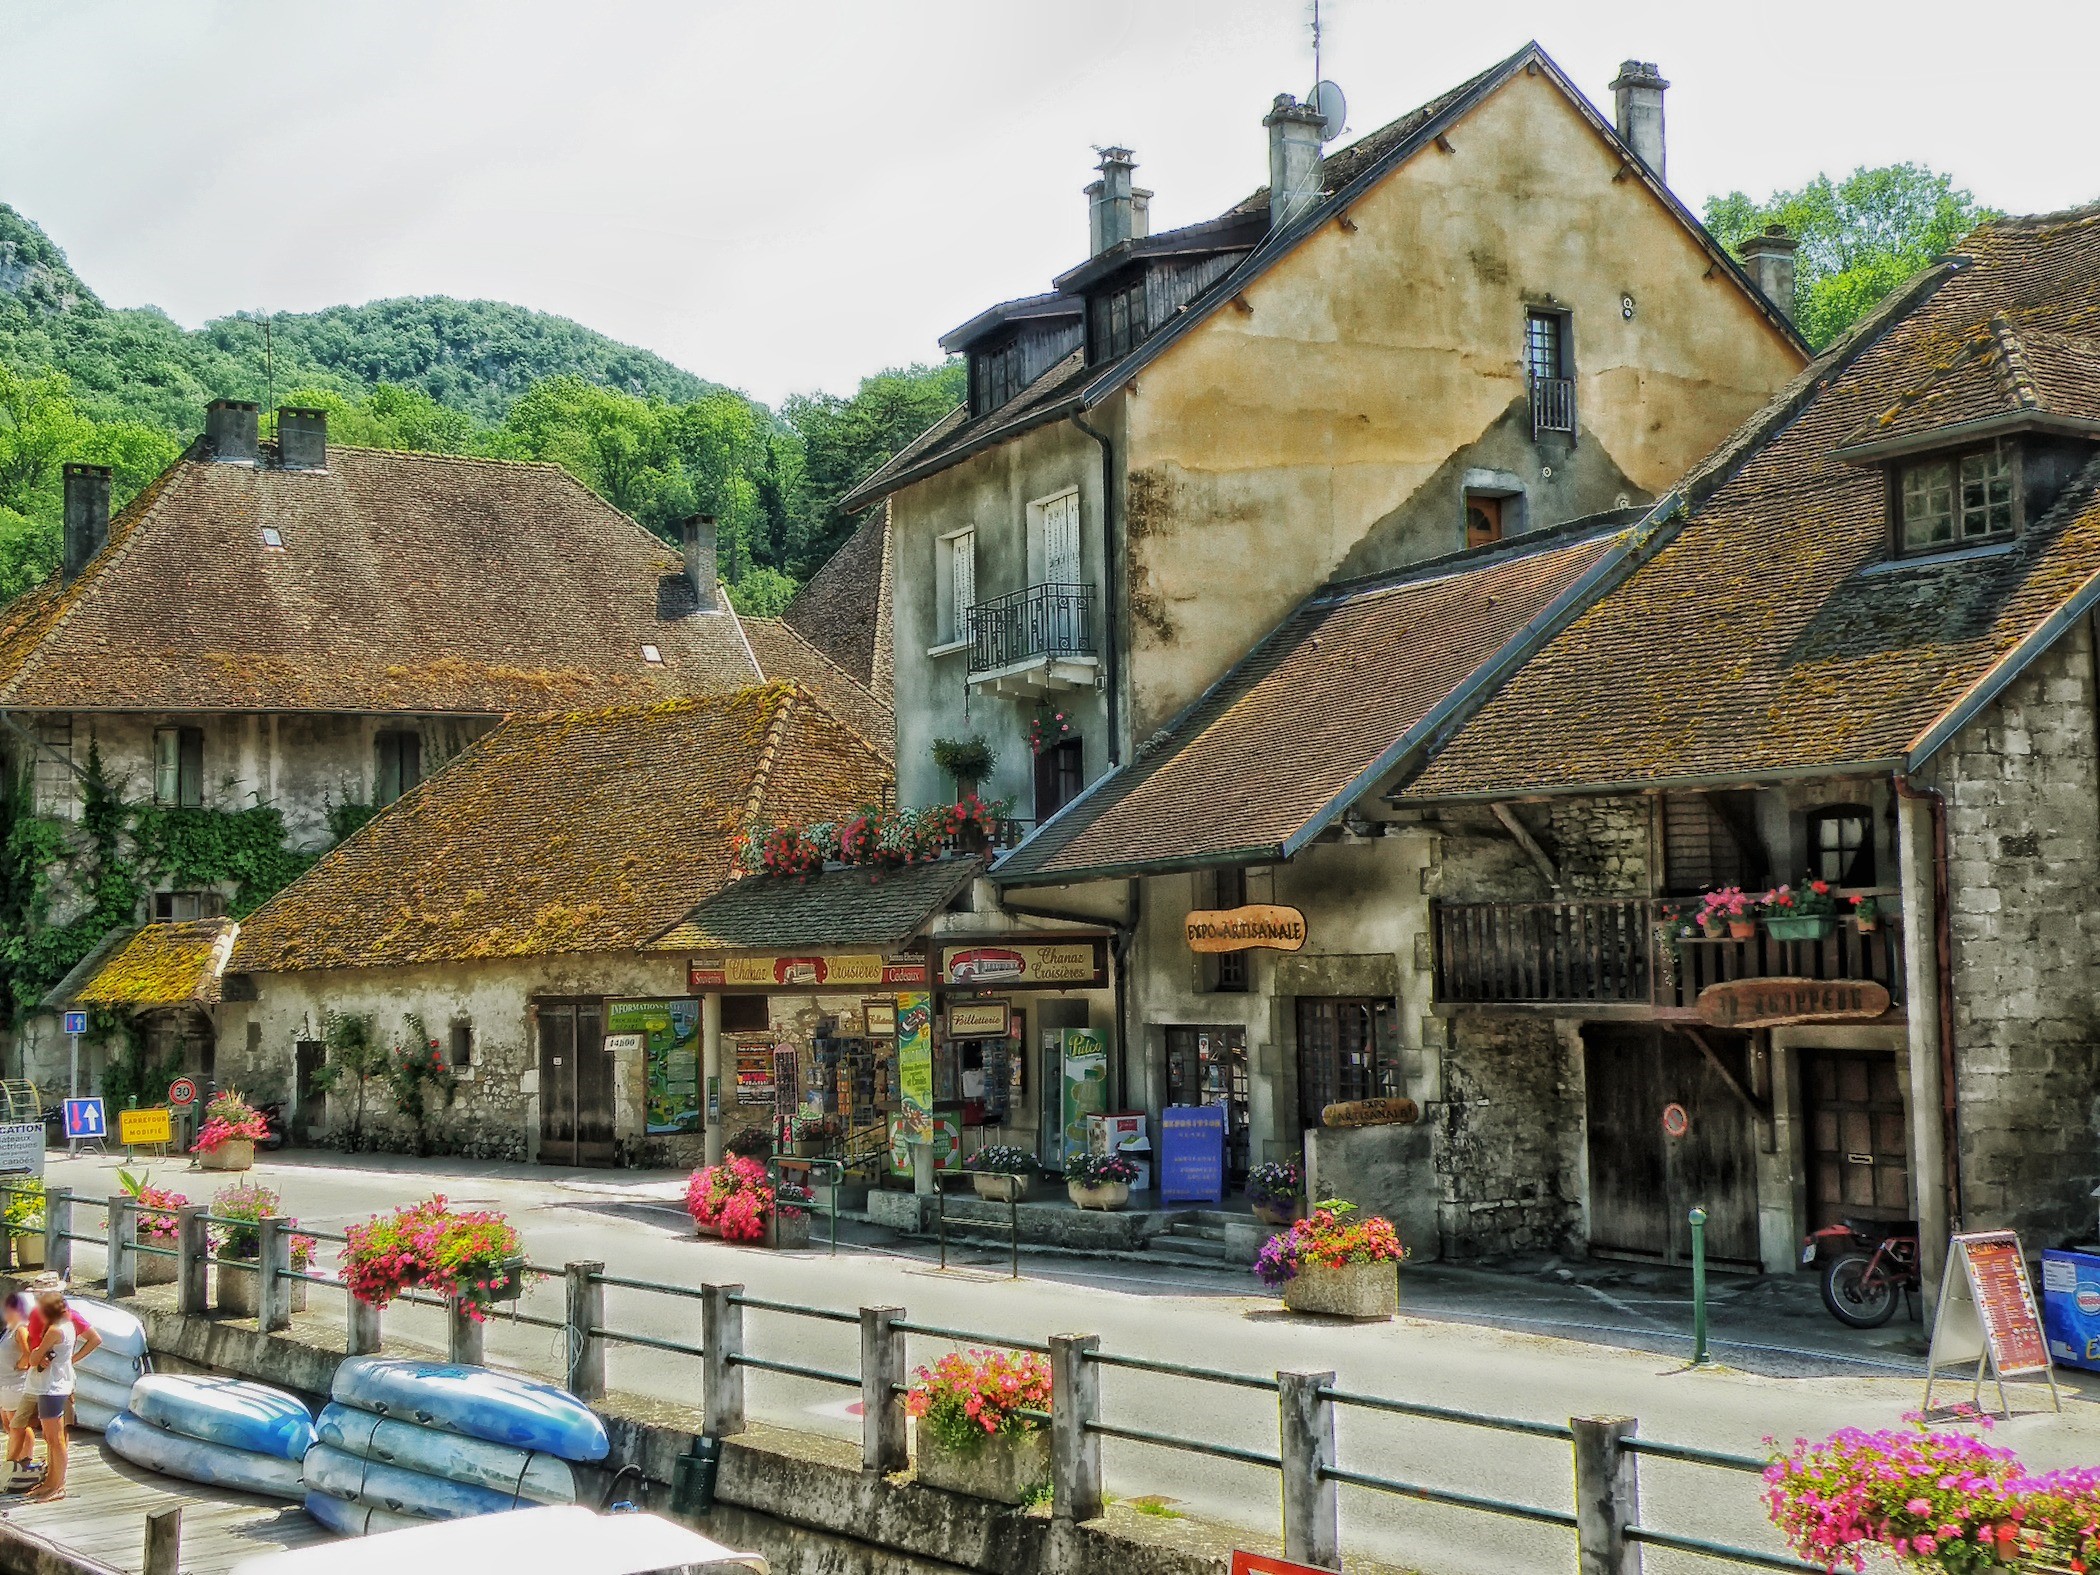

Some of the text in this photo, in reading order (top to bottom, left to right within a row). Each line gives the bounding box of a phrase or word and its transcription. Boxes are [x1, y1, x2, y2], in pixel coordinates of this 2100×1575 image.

[1187, 921, 1301, 940] EXPO ARTISANALE
[1037, 947, 1086, 964] Chanaz
[828, 957, 880, 980] Croisières
[1031, 962, 1085, 980] Croisières
[611, 1003, 663, 1016] INFORMATIONS
[952, 1013, 1001, 1026] Billetterie
[610, 1038, 635, 1047] 14h00
[1069, 1034, 1102, 1057] Pulco
[176, 1087, 190, 1097] 30
[123, 1115, 167, 1125] CARREFOUR
[0, 1124, 43, 1134] CATION
[1, 1135, 31, 1143] ateaux
[0, 1142, 38, 1151] ctriques
